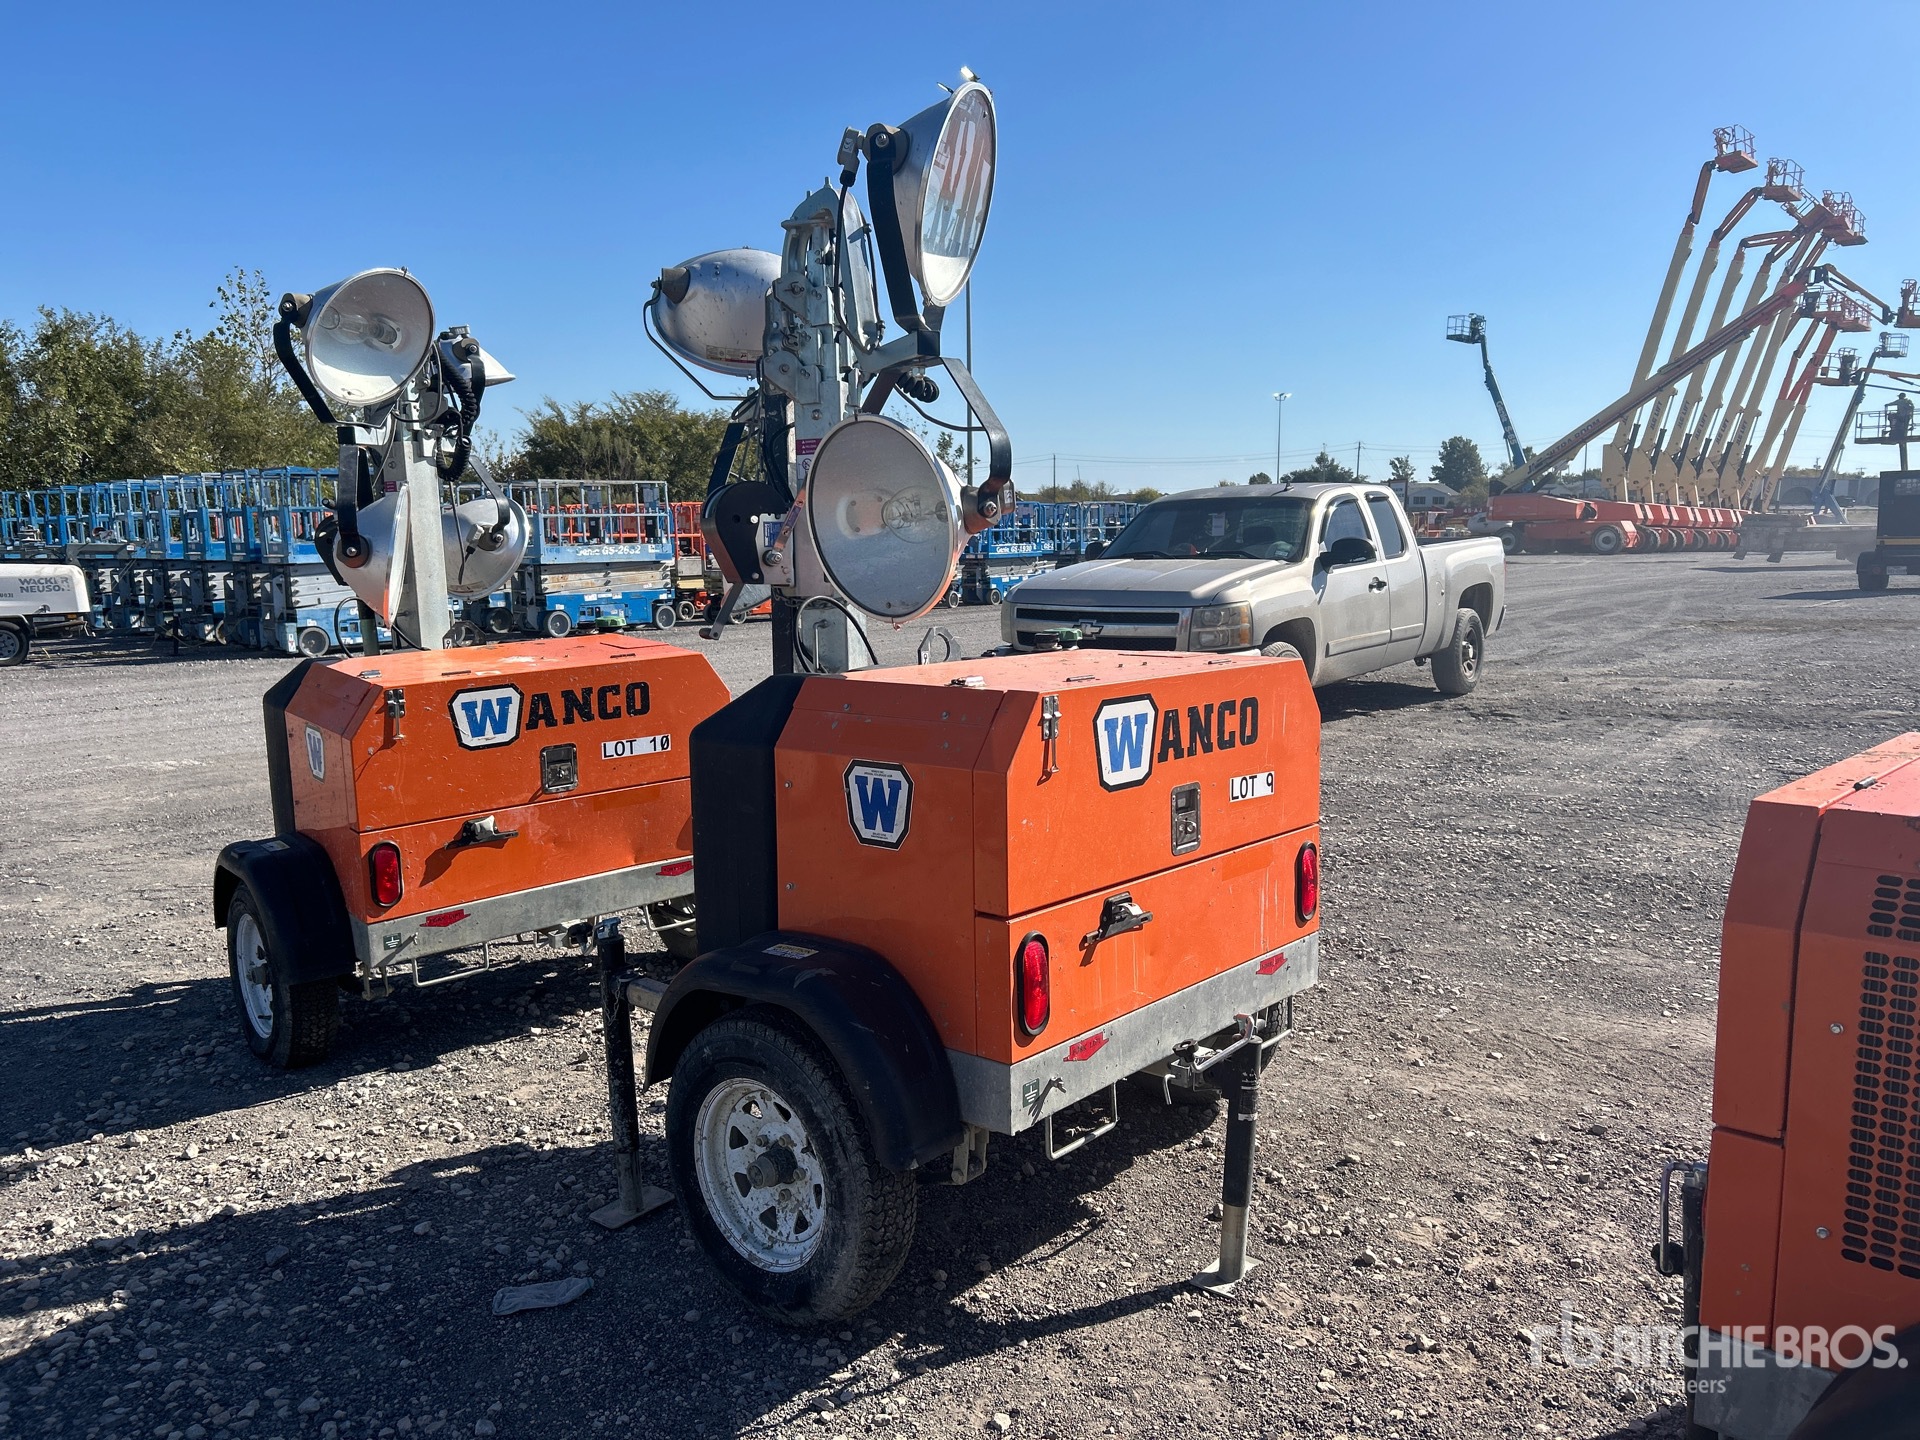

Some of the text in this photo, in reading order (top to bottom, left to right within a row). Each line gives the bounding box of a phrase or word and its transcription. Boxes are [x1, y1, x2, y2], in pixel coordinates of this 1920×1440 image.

[460, 681, 651, 738] WANCO
[1104, 696, 1259, 773] WANCO
[603, 734, 671, 758] LOT 10
[854, 774, 902, 834] W
[1231, 772, 1275, 801] LOT 9
